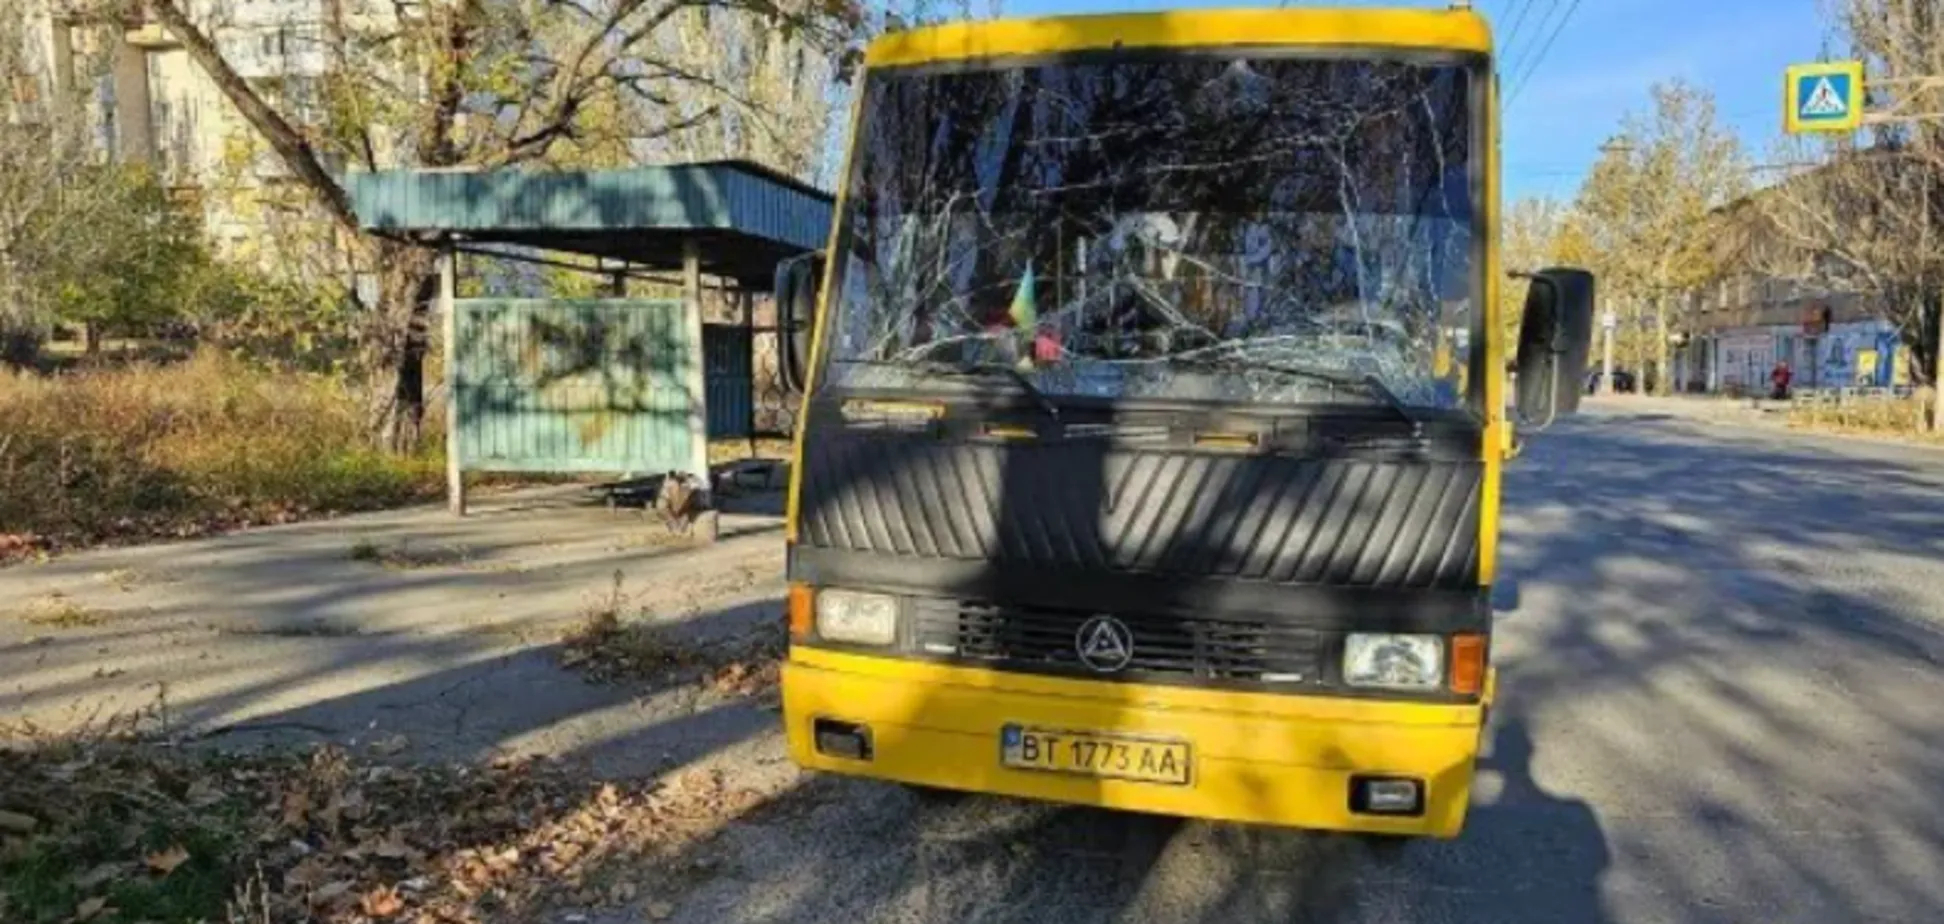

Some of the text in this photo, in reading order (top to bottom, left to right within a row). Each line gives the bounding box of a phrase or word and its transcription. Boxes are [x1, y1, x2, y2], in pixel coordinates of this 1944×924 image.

[1023, 735, 1177, 775] BT 1773 AA
